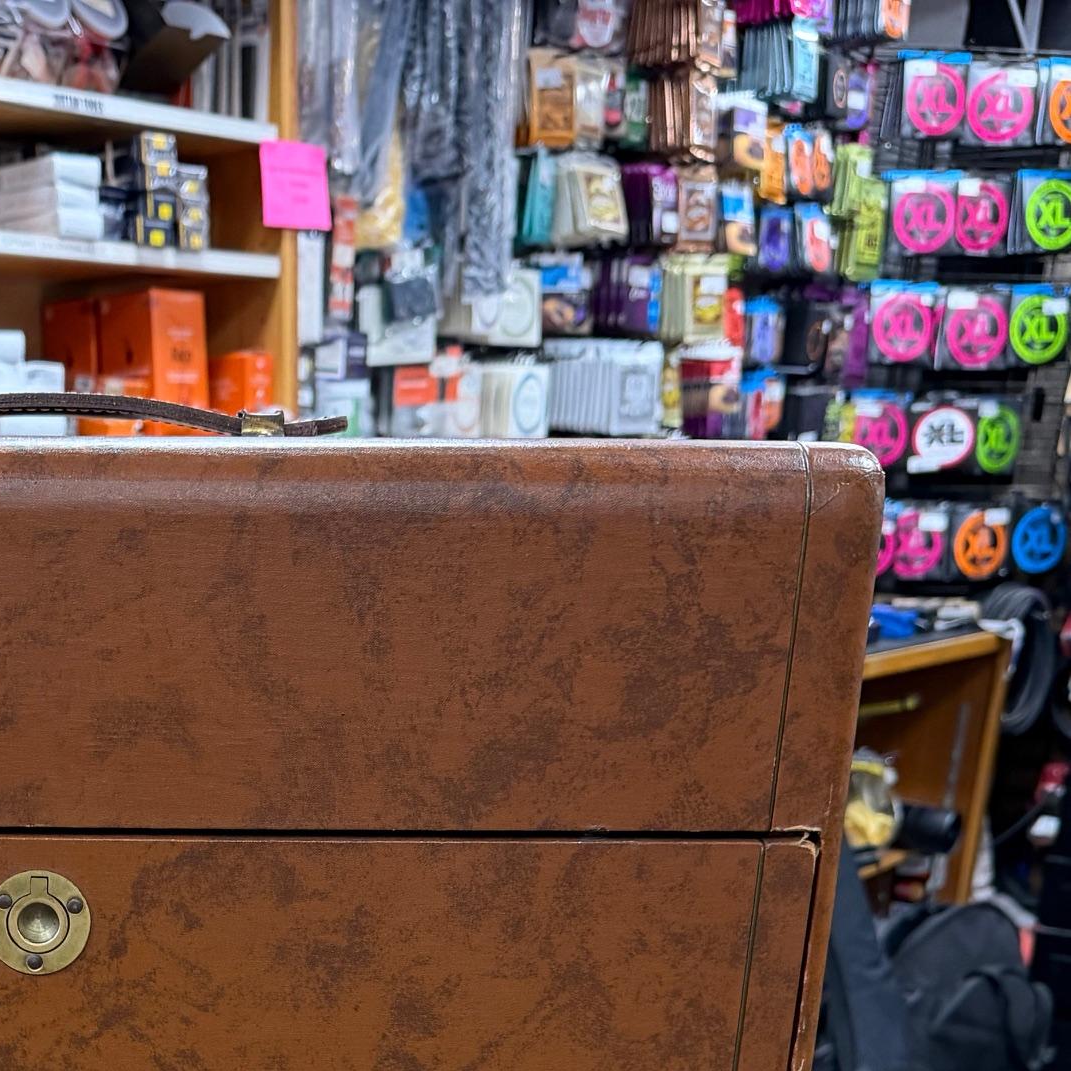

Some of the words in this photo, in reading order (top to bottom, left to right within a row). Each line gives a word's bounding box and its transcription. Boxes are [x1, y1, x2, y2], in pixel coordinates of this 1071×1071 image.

[917, 85, 956, 113] XL
[981, 90, 1020, 120] XL
[906, 202, 944, 231] XL
[964, 200, 996, 231] XL
[1037, 200, 1071, 229] XL
[886, 313, 920, 339] XL
[1022, 316, 1055, 341] XL
[925, 422, 964, 445] XL
